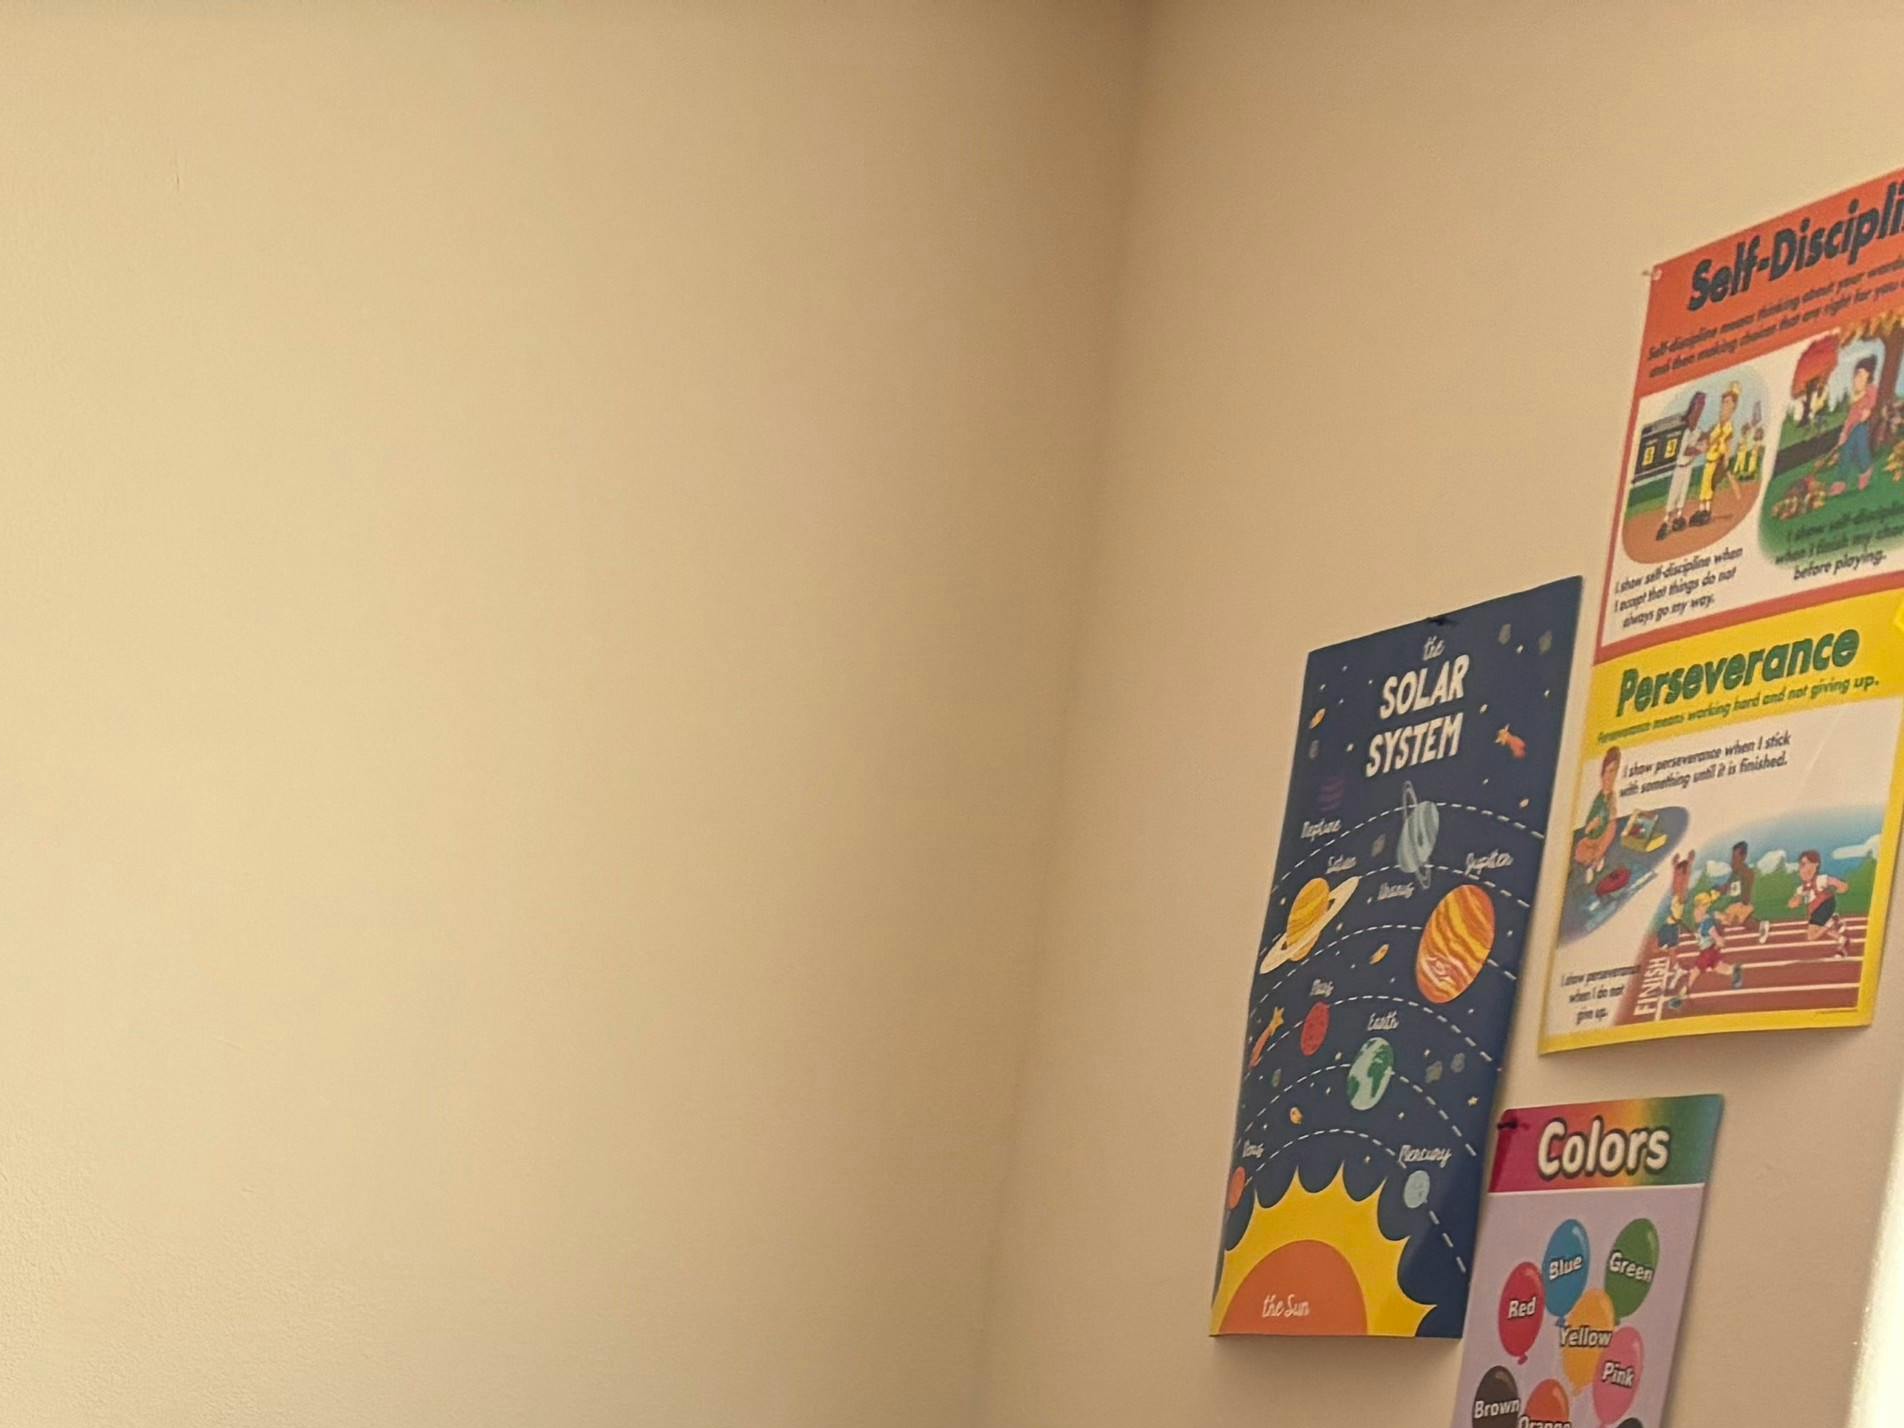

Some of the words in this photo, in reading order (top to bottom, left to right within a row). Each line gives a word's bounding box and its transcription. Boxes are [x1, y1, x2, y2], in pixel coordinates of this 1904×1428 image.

[1616, 628, 1861, 718] Perseverance
[1379, 654, 1470, 720] SOLAR
[1810, 676, 1851, 700] giving
[1853, 674, 1880, 693] up.
[1365, 712, 1465, 778] SYSTEM
[1765, 730, 1792, 749] stick
[1739, 750, 1788, 774] finished.
[1633, 957, 1671, 1016] FINISH
[1367, 1010, 1400, 1032] Earth
[1537, 1116, 1672, 1179] Colors
[1548, 1255, 1583, 1281] Blue
[1609, 1252, 1655, 1283] Green
[1261, 1295, 1284, 1319] the
[1284, 1294, 1311, 1318] Sun
[1508, 1297, 1537, 1319] Red
[1559, 1327, 1613, 1348] Yellow
[1602, 1361, 1634, 1388] Pink
[1473, 1399, 1520, 1420] Brown
